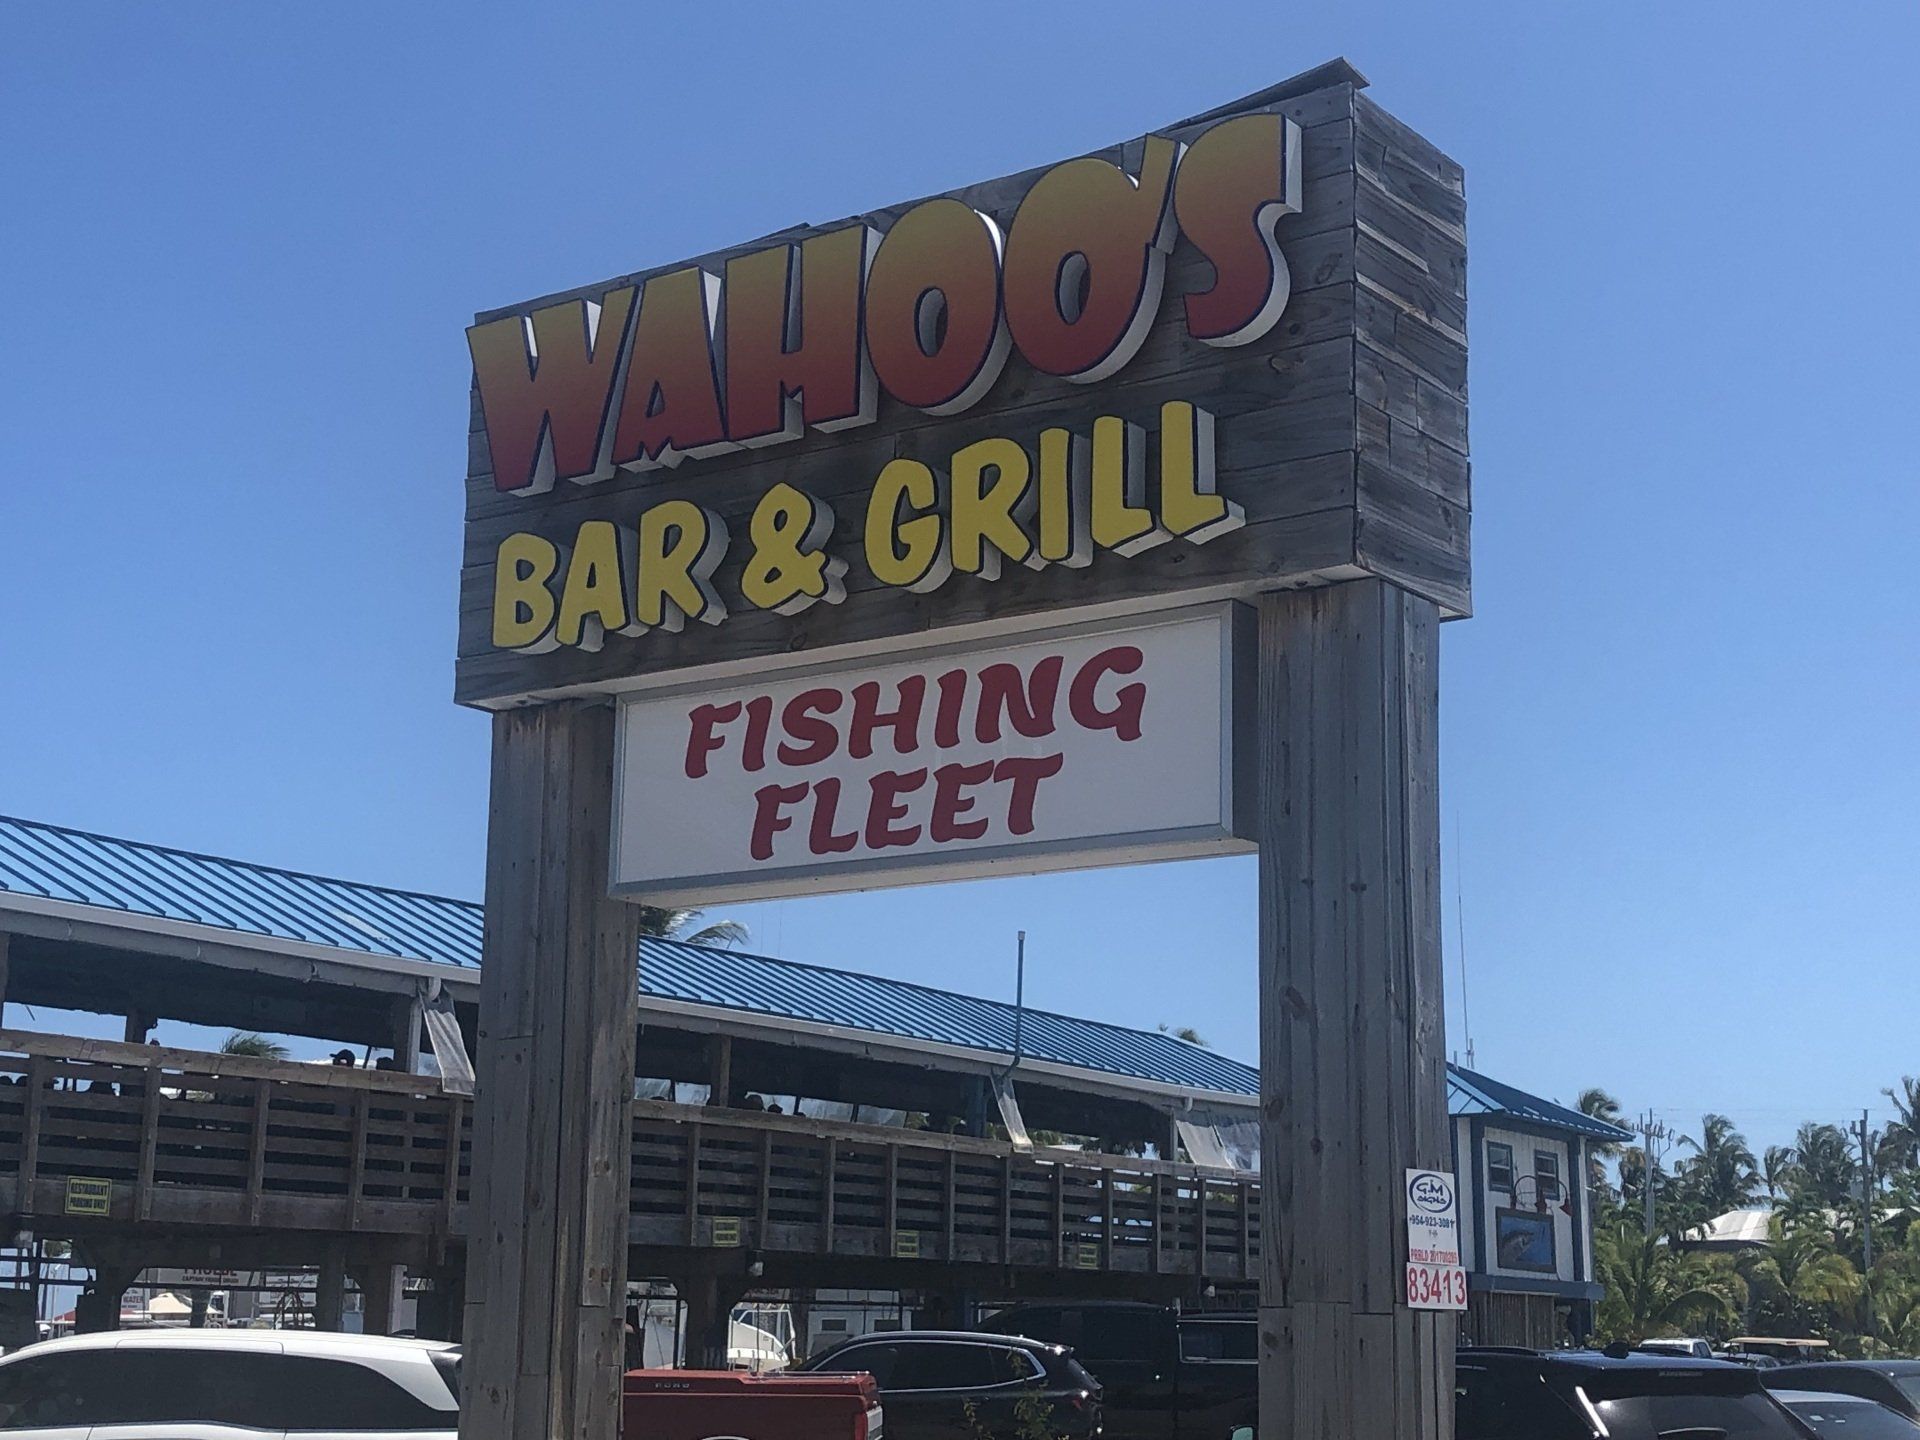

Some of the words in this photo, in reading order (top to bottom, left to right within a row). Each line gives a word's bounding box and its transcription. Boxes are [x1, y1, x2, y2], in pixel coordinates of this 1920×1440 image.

[467, 113, 1300, 495] WAHOO'S
[493, 500, 722, 652] BAR
[741, 482, 842, 614] &
[865, 401, 1240, 590] GRILL
[684, 645, 1147, 779] FISHING
[750, 753, 1064, 861] FLEET
[1408, 1267, 1466, 1305] 83413
